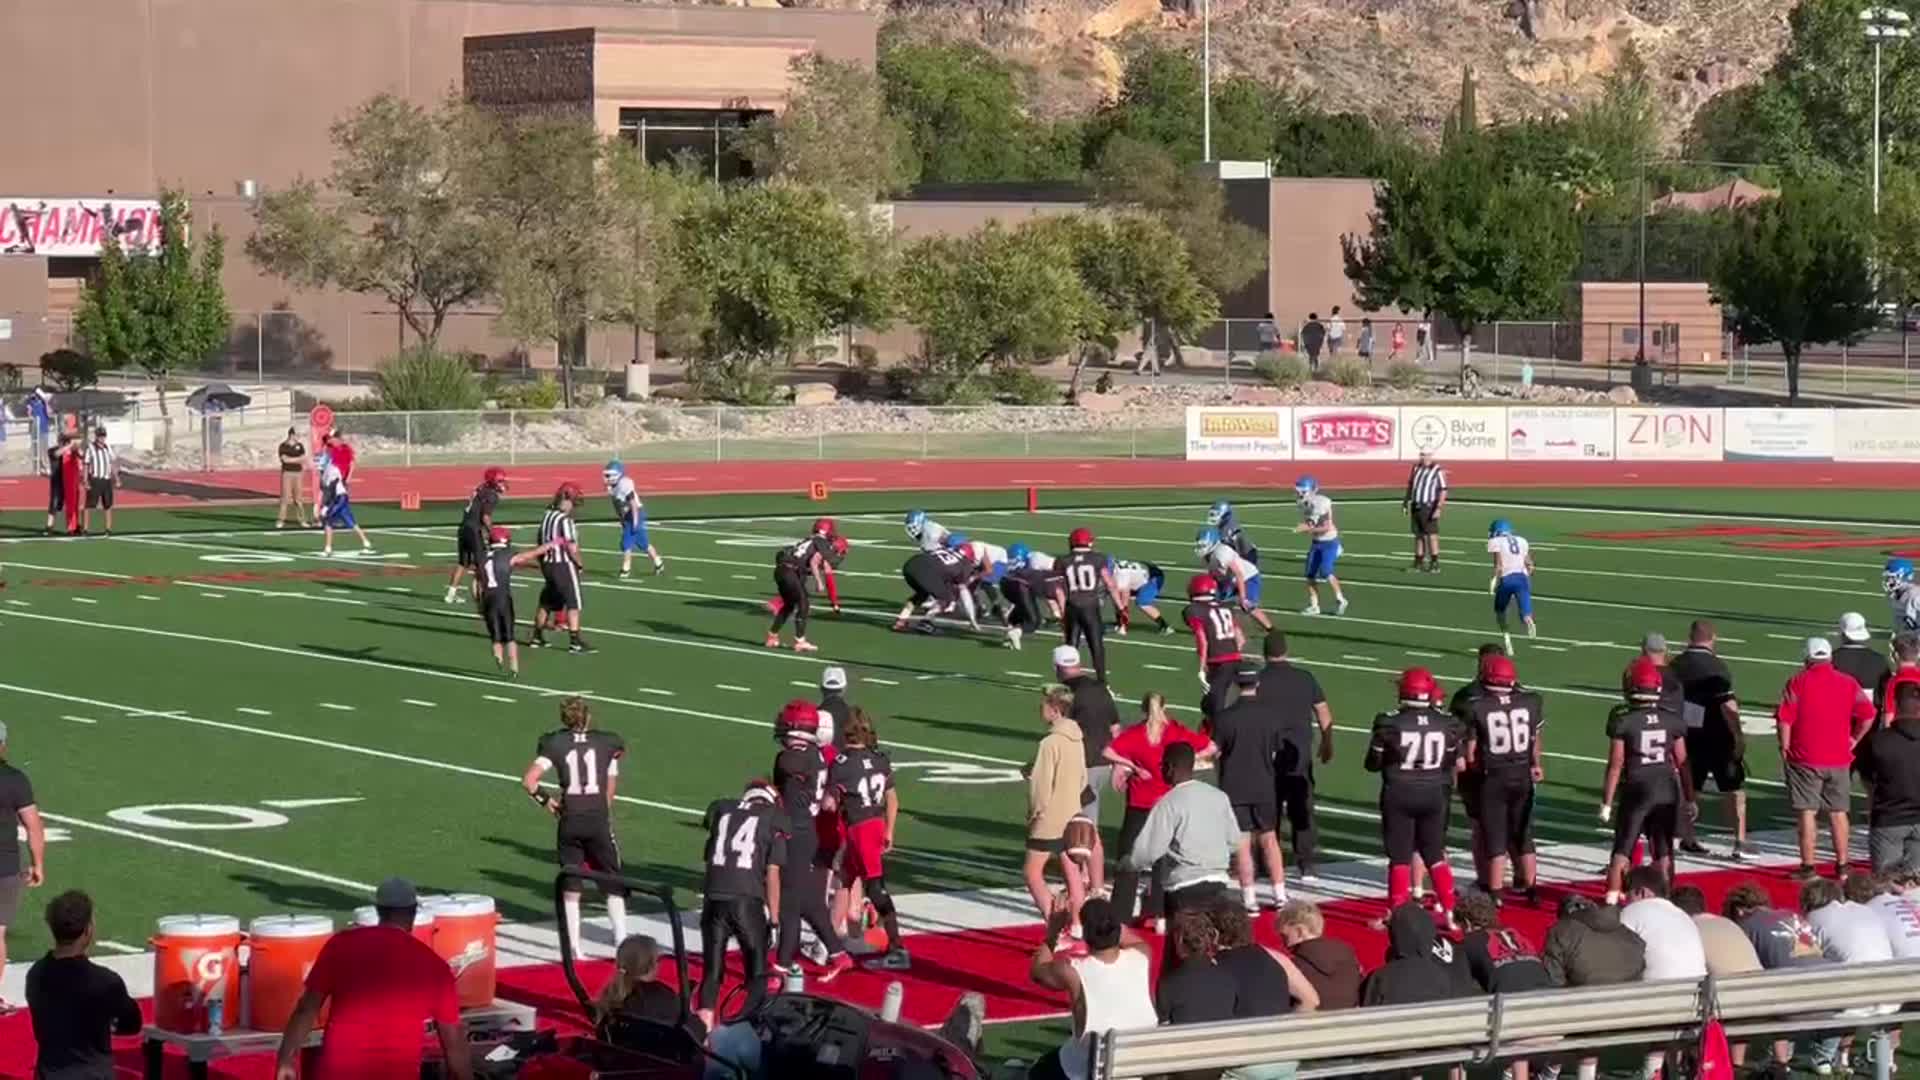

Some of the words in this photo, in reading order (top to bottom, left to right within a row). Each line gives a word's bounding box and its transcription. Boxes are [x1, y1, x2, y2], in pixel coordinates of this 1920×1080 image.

[1303, 420, 1390, 444] ERNIE'S
[1451, 419, 1485, 432] Blvd
[1628, 415, 1711, 443] ZION
[1451, 436, 1496, 447] Home
[815, 484, 825, 496] G
[1507, 536, 1519, 555] 8
[484, 560, 498, 588] 1
[1066, 565, 1095, 591] 10
[1209, 607, 1234, 640] 18
[1487, 708, 1531, 754] 66
[1400, 731, 1445, 770] 70
[1640, 729, 1667, 764] 5
[565, 749, 600, 795] 11
[105, 803, 290, 830] 0
[712, 813, 760, 869] 14
[198, 952, 223, 980] G
